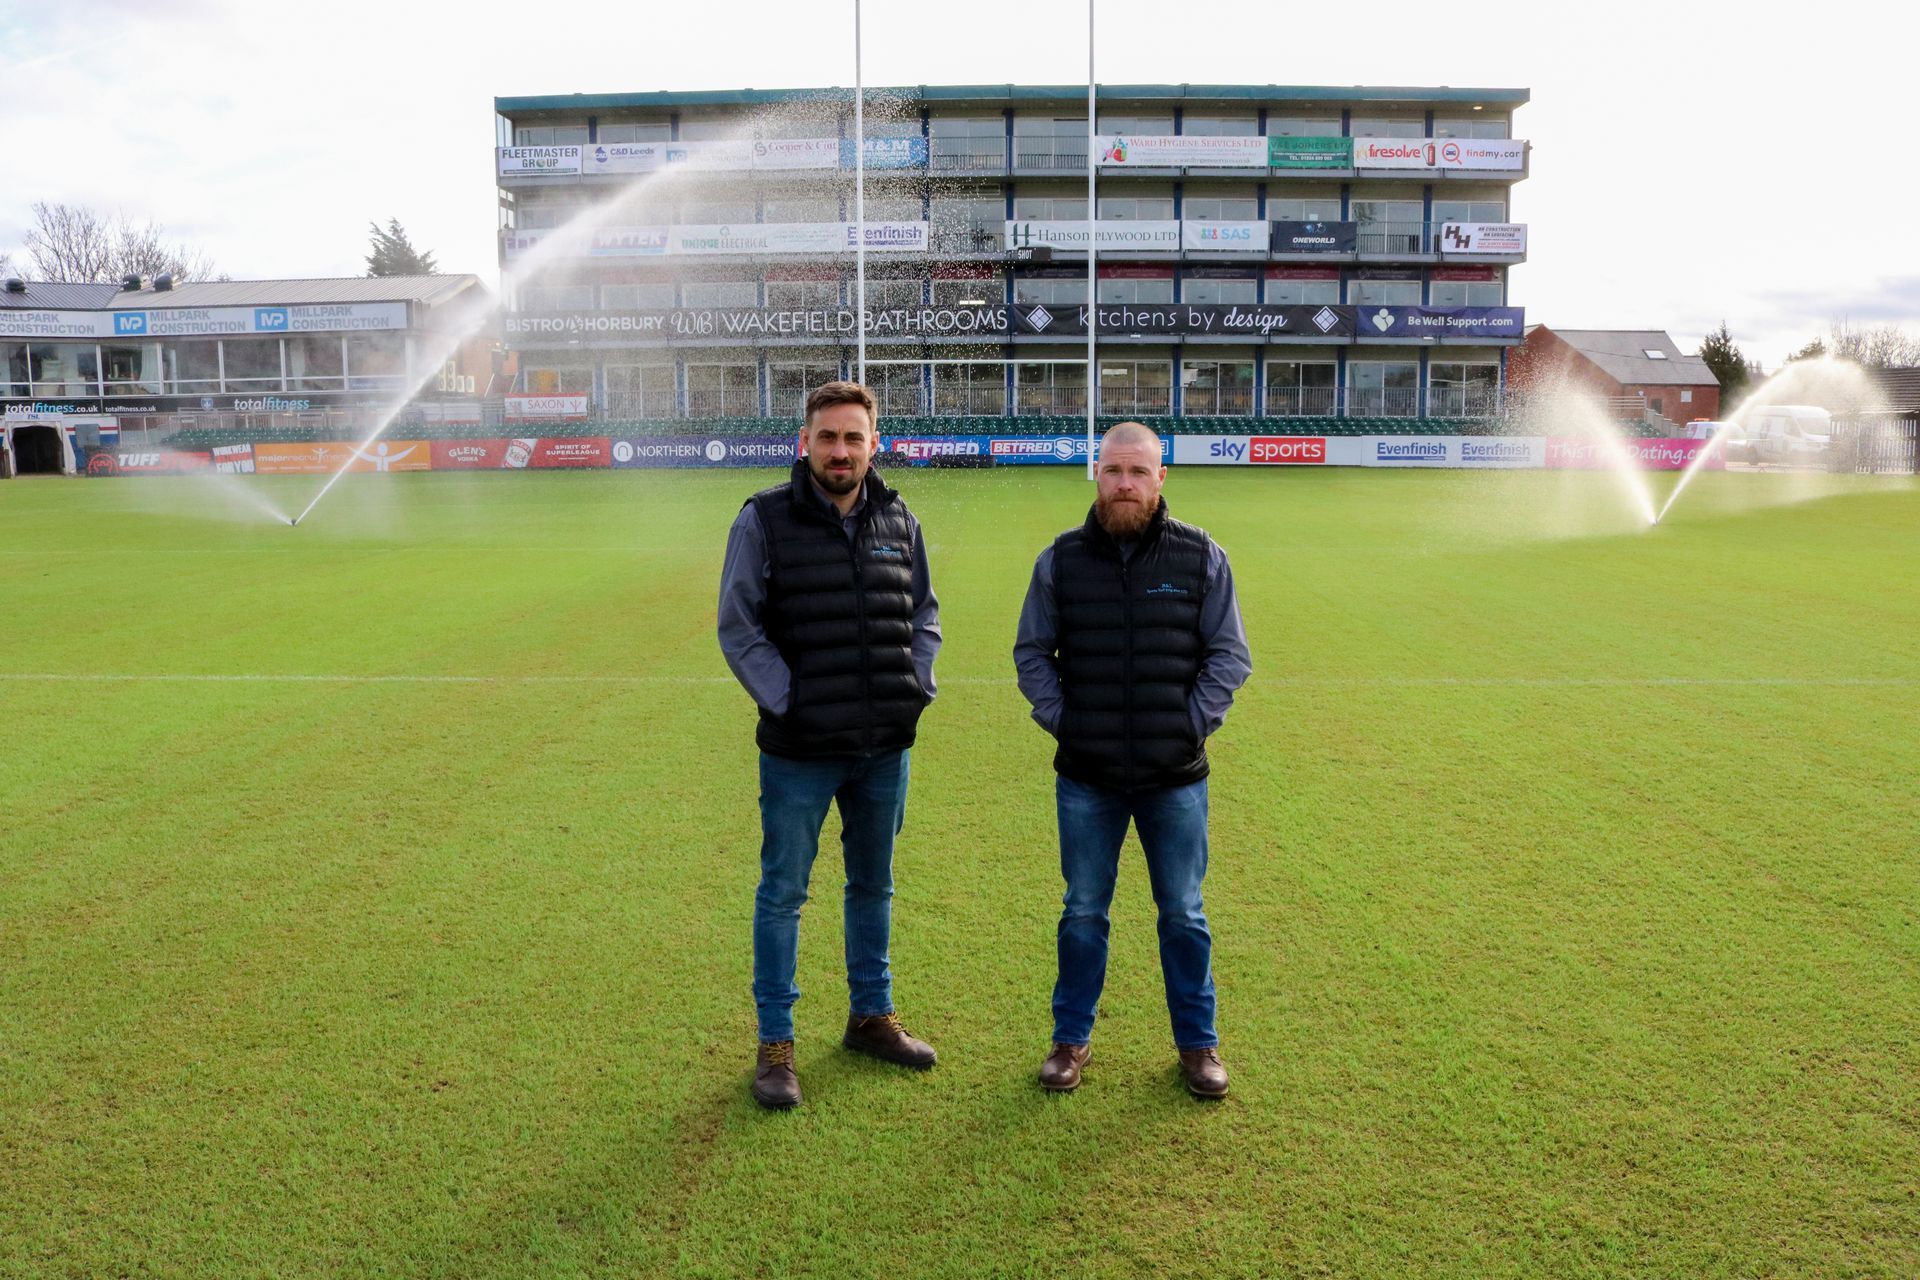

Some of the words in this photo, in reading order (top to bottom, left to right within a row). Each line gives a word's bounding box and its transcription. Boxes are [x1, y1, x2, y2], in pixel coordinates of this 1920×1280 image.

[1130, 138, 1157, 148] WARD
[1158, 138, 1199, 148] HYGIENE
[1201, 138, 1241, 148] SERVICES
[1243, 138, 1262, 148] LTD
[502, 147, 578, 159] FLEETMASTER
[1368, 144, 1421, 158] firesolve
[1466, 150, 1520, 158] findmy.car
[848, 226, 922, 239] Eenfinish
[1038, 229, 1090, 241] Hanson
[1094, 232, 1151, 241] PLYWOOD
[1154, 231, 1177, 241] LTD
[1221, 228, 1250, 240] SAS
[682, 239, 719, 249] UNIQUE
[1292, 236, 1336, 244] ONEWORLD
[1018, 249, 1032, 260] SHOT
[150, 310, 211, 322] MILLPARK
[291, 306, 353, 318] MILLPARK
[0, 313, 59, 324] MILLPARK
[292, 317, 389, 330] CONSTRUCTION
[506, 318, 564, 332] BISTRO
[585, 316, 664, 331] HORBURY
[721, 311, 854, 333] WAKEFIELD
[862, 310, 1007, 331] BATHROOMS
[1079, 306, 1177, 326] ktchens
[1189, 306, 1214, 330] by
[1223, 307, 1288, 334] design
[1408, 316, 1421, 326] Be
[1422, 316, 1445, 326] Well
[1446, 317, 1487, 328] Support
[1488, 317, 1513, 326] .com
[0, 323, 95, 335] CONSTRUCTION
[151, 321, 246, 334] CONSTRUCTION
[5, 402, 98, 413] totalfitness.co.uk
[234, 396, 310, 411] totalfitness
[527, 399, 565, 409] SAXON
[448, 446, 487, 458] GLEN'S
[637, 445, 701, 457] NORTHERN
[730, 445, 795, 456] NORTHERN
[896, 442, 979, 457] BETFRED
[993, 442, 1053, 454] BETFRED
[1076, 441, 1100, 453] SUP
[1210, 438, 1246, 461] sky
[1254, 441, 1321, 458] sports
[1377, 442, 1447, 455] Evenfinish
[1462, 442, 1530, 455] Evenfinish
